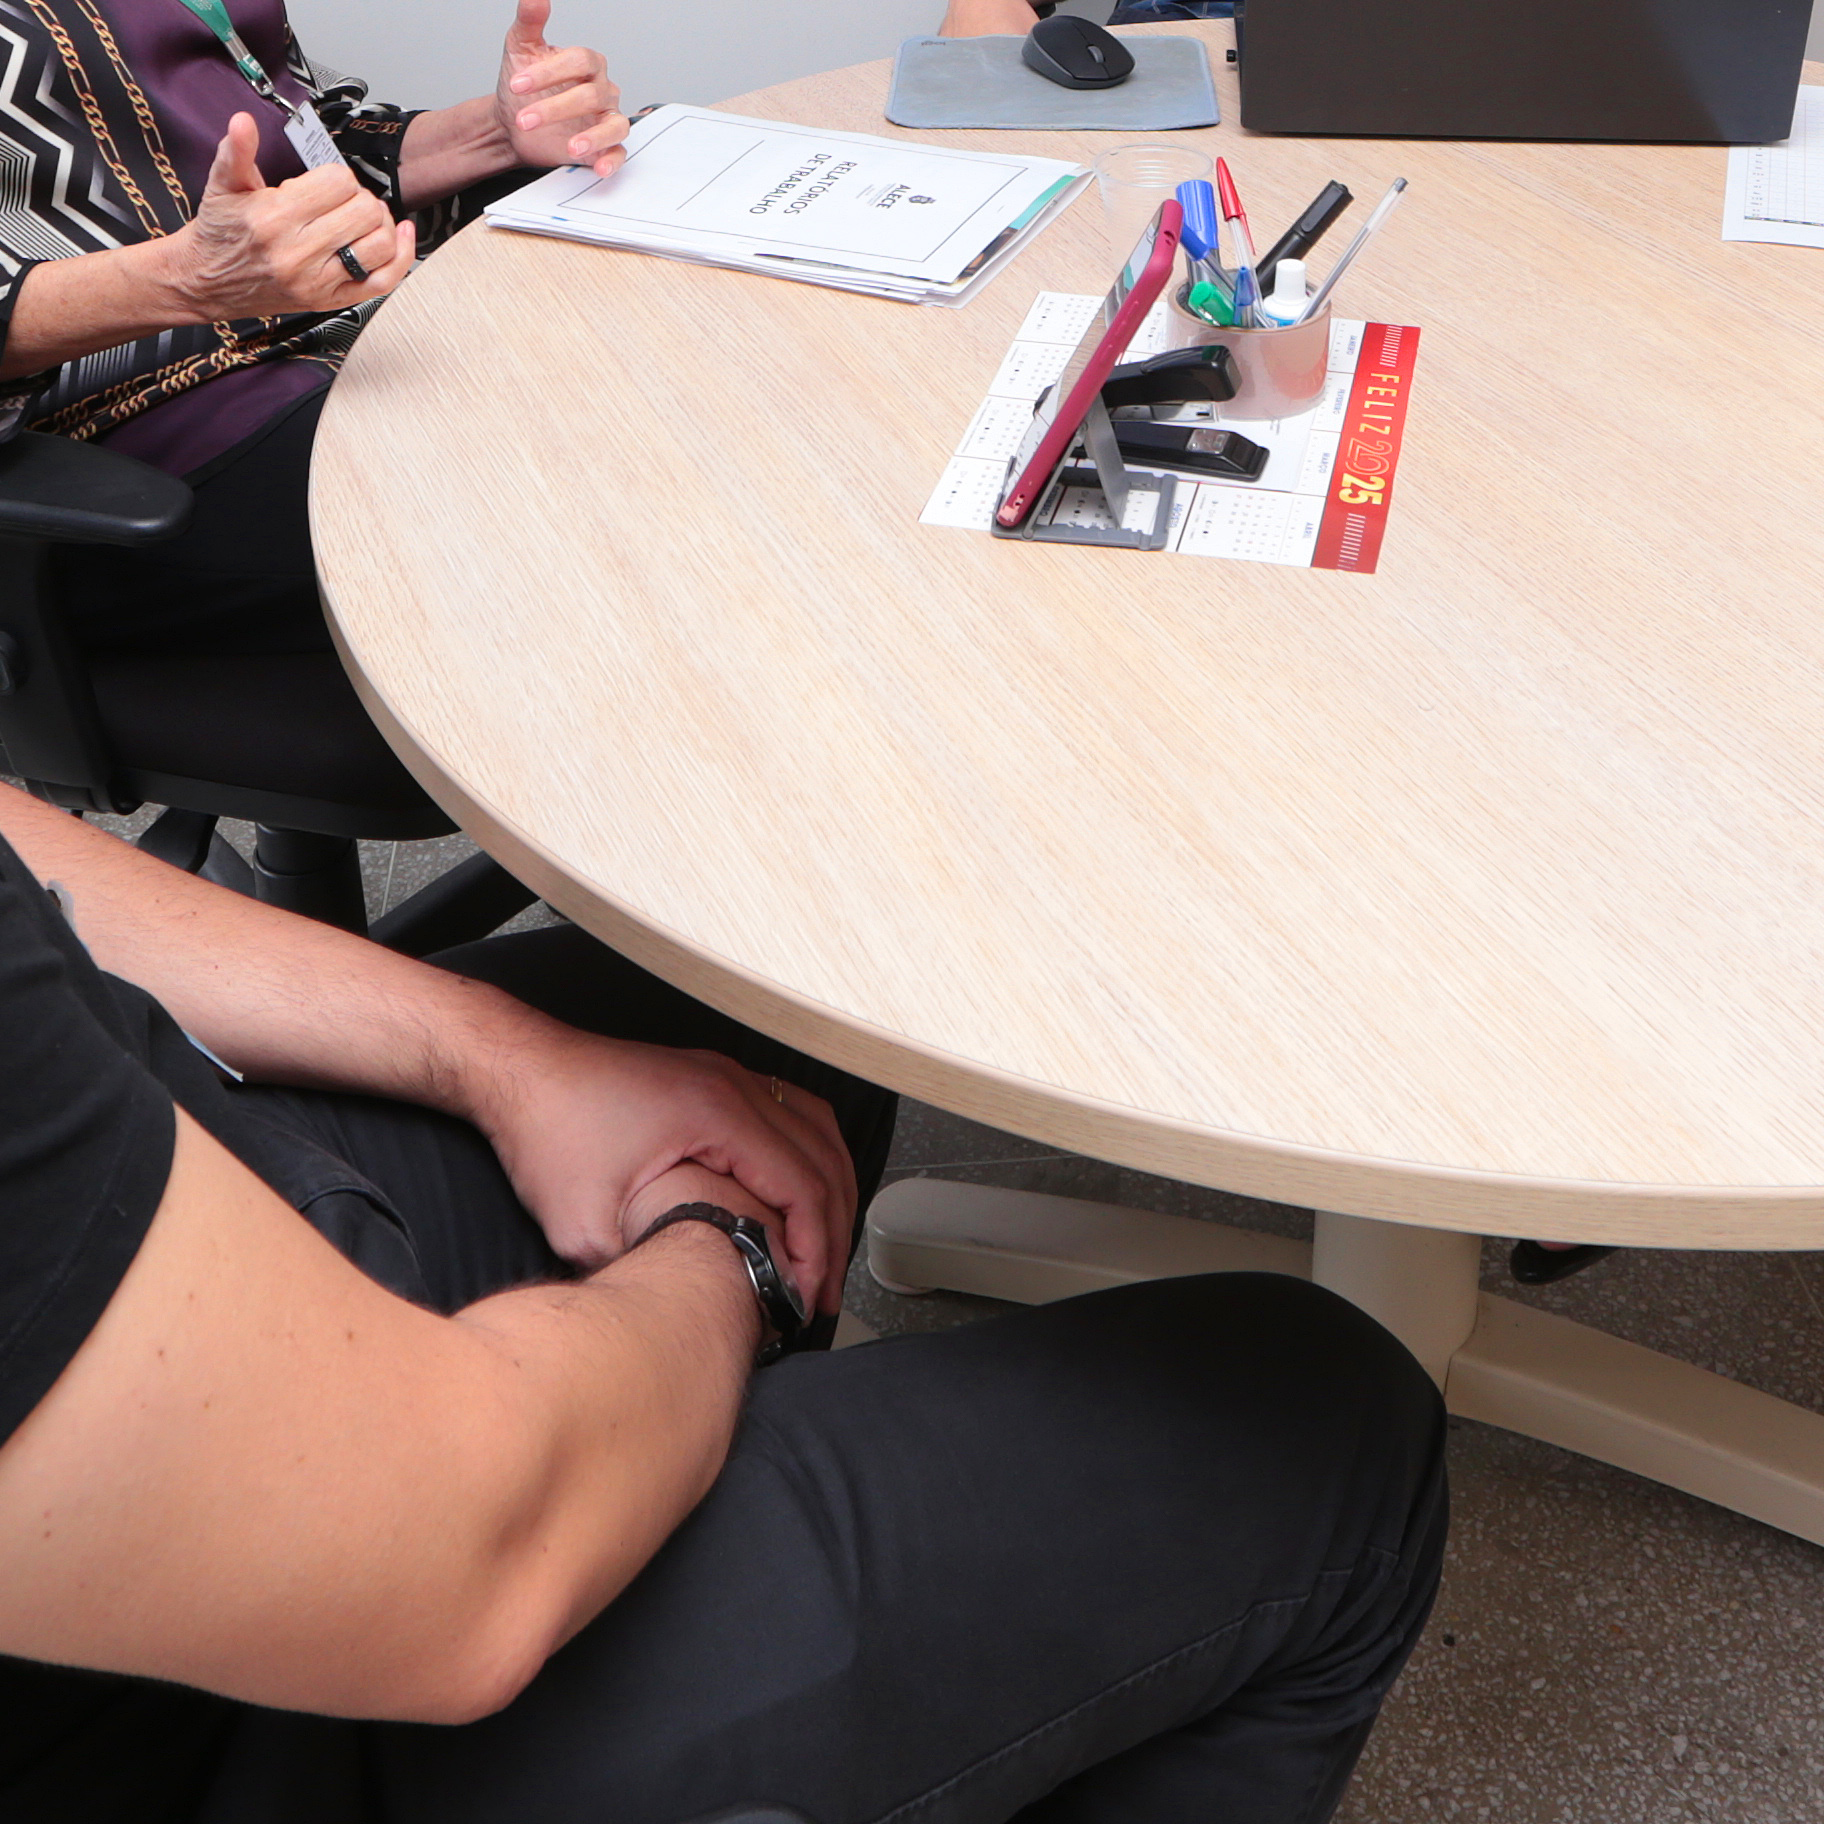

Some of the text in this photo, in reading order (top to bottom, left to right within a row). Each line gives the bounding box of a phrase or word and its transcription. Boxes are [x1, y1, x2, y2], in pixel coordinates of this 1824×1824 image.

[749, 153, 832, 215] DE TRABALHO
[783, 161, 858, 215] RELATÓRIOS
[876, 184, 911, 209] ALECE
[1338, 373, 1400, 505] FELIZ 2025
